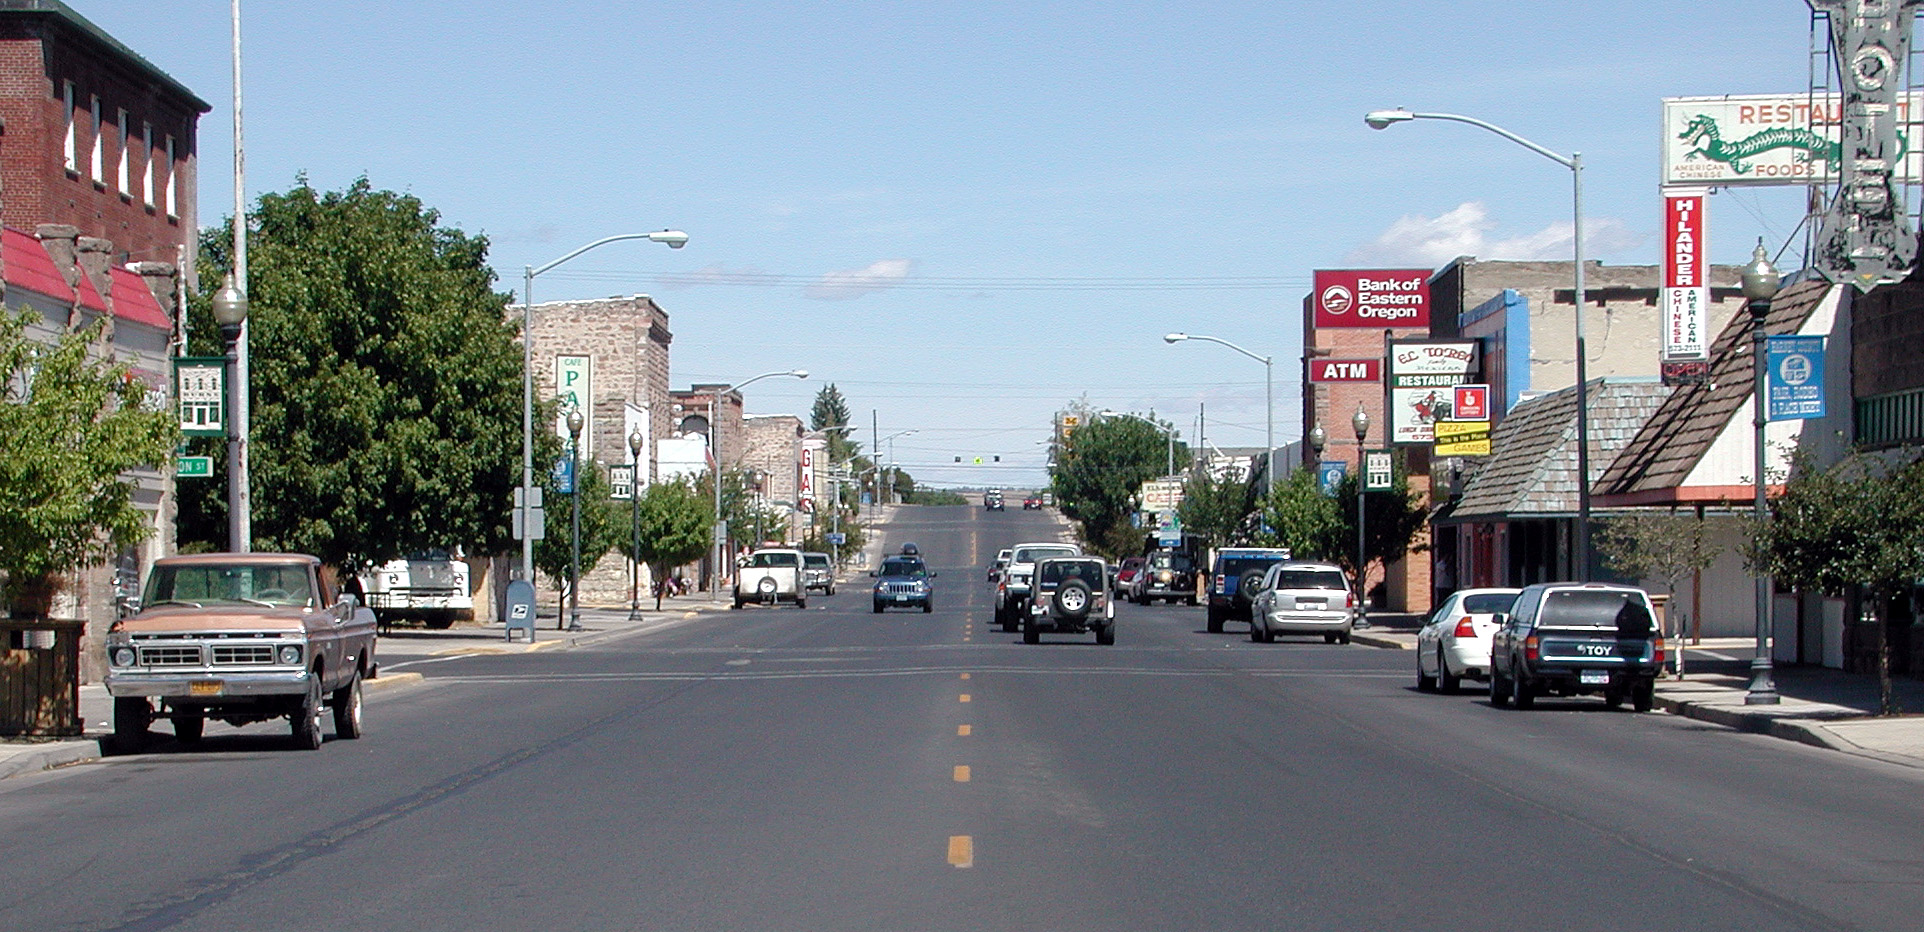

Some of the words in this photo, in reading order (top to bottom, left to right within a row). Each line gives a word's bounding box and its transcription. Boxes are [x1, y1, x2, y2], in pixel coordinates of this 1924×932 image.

[1739, 102, 1909, 125] RESTAUT
[1674, 164, 1726, 172] AMERICAN
[1756, 164, 1816, 177] FOODS
[1679, 171, 1723, 179] CHINESE
[1675, 199, 1694, 286] HILANDER
[1357, 278, 1400, 291] Bank
[1400, 277, 1421, 291] of
[1357, 292, 1423, 305] Eastern
[1357, 305, 1418, 320] Oregon
[1673, 289, 1683, 344] CHINESE
[1686, 289, 1697, 343] AMERICAN
[1397, 350, 1419, 364] EL
[1422, 347, 1475, 364] TOREO
[563, 358, 582, 367] CAFE
[1323, 363, 1367, 379] ATM
[1397, 375, 1476, 387] RESTAURANT
[1438, 424, 1467, 432] PIZZA
[1453, 443, 1488, 453] GAMES
[195, 462, 206, 471] ST
[800, 448, 813, 512] GAS
[1586, 645, 1612, 656] TOY
